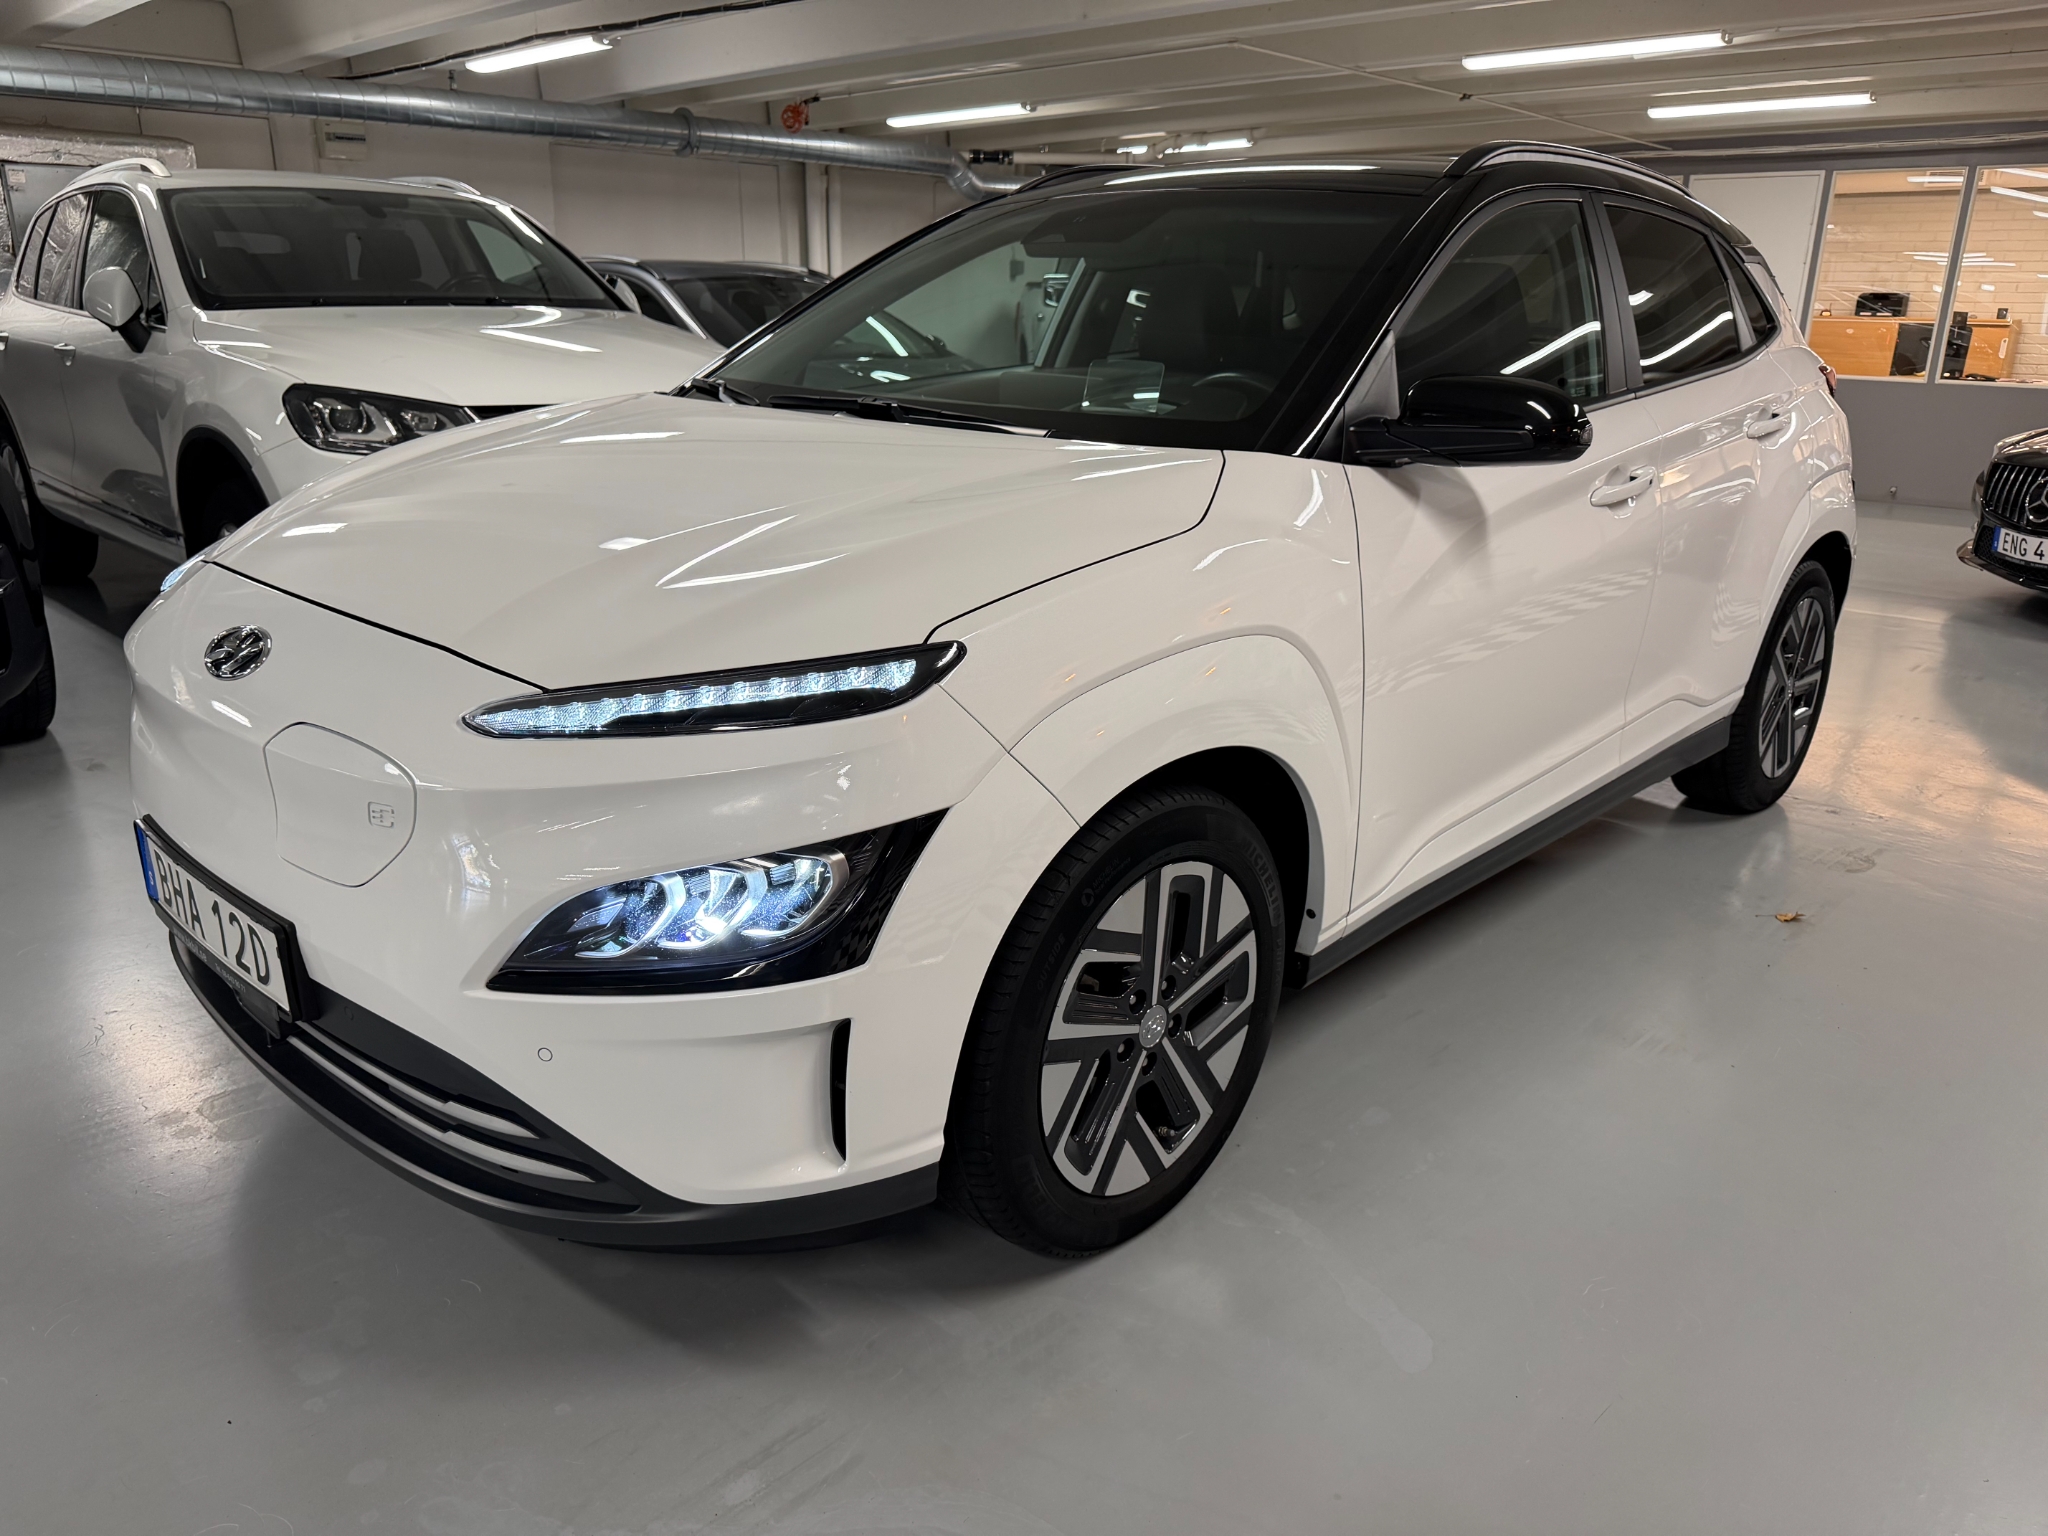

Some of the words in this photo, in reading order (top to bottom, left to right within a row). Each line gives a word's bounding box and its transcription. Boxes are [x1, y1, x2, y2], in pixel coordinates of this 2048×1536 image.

[2003, 532, 2028, 557] ENG
[2033, 541, 2046, 560] 4
[1241, 837, 1282, 919] MICHELIN
[154, 848, 207, 942] BHA
[211, 899, 271, 986] 12D
[1036, 932, 1066, 990] OUTSIDE
